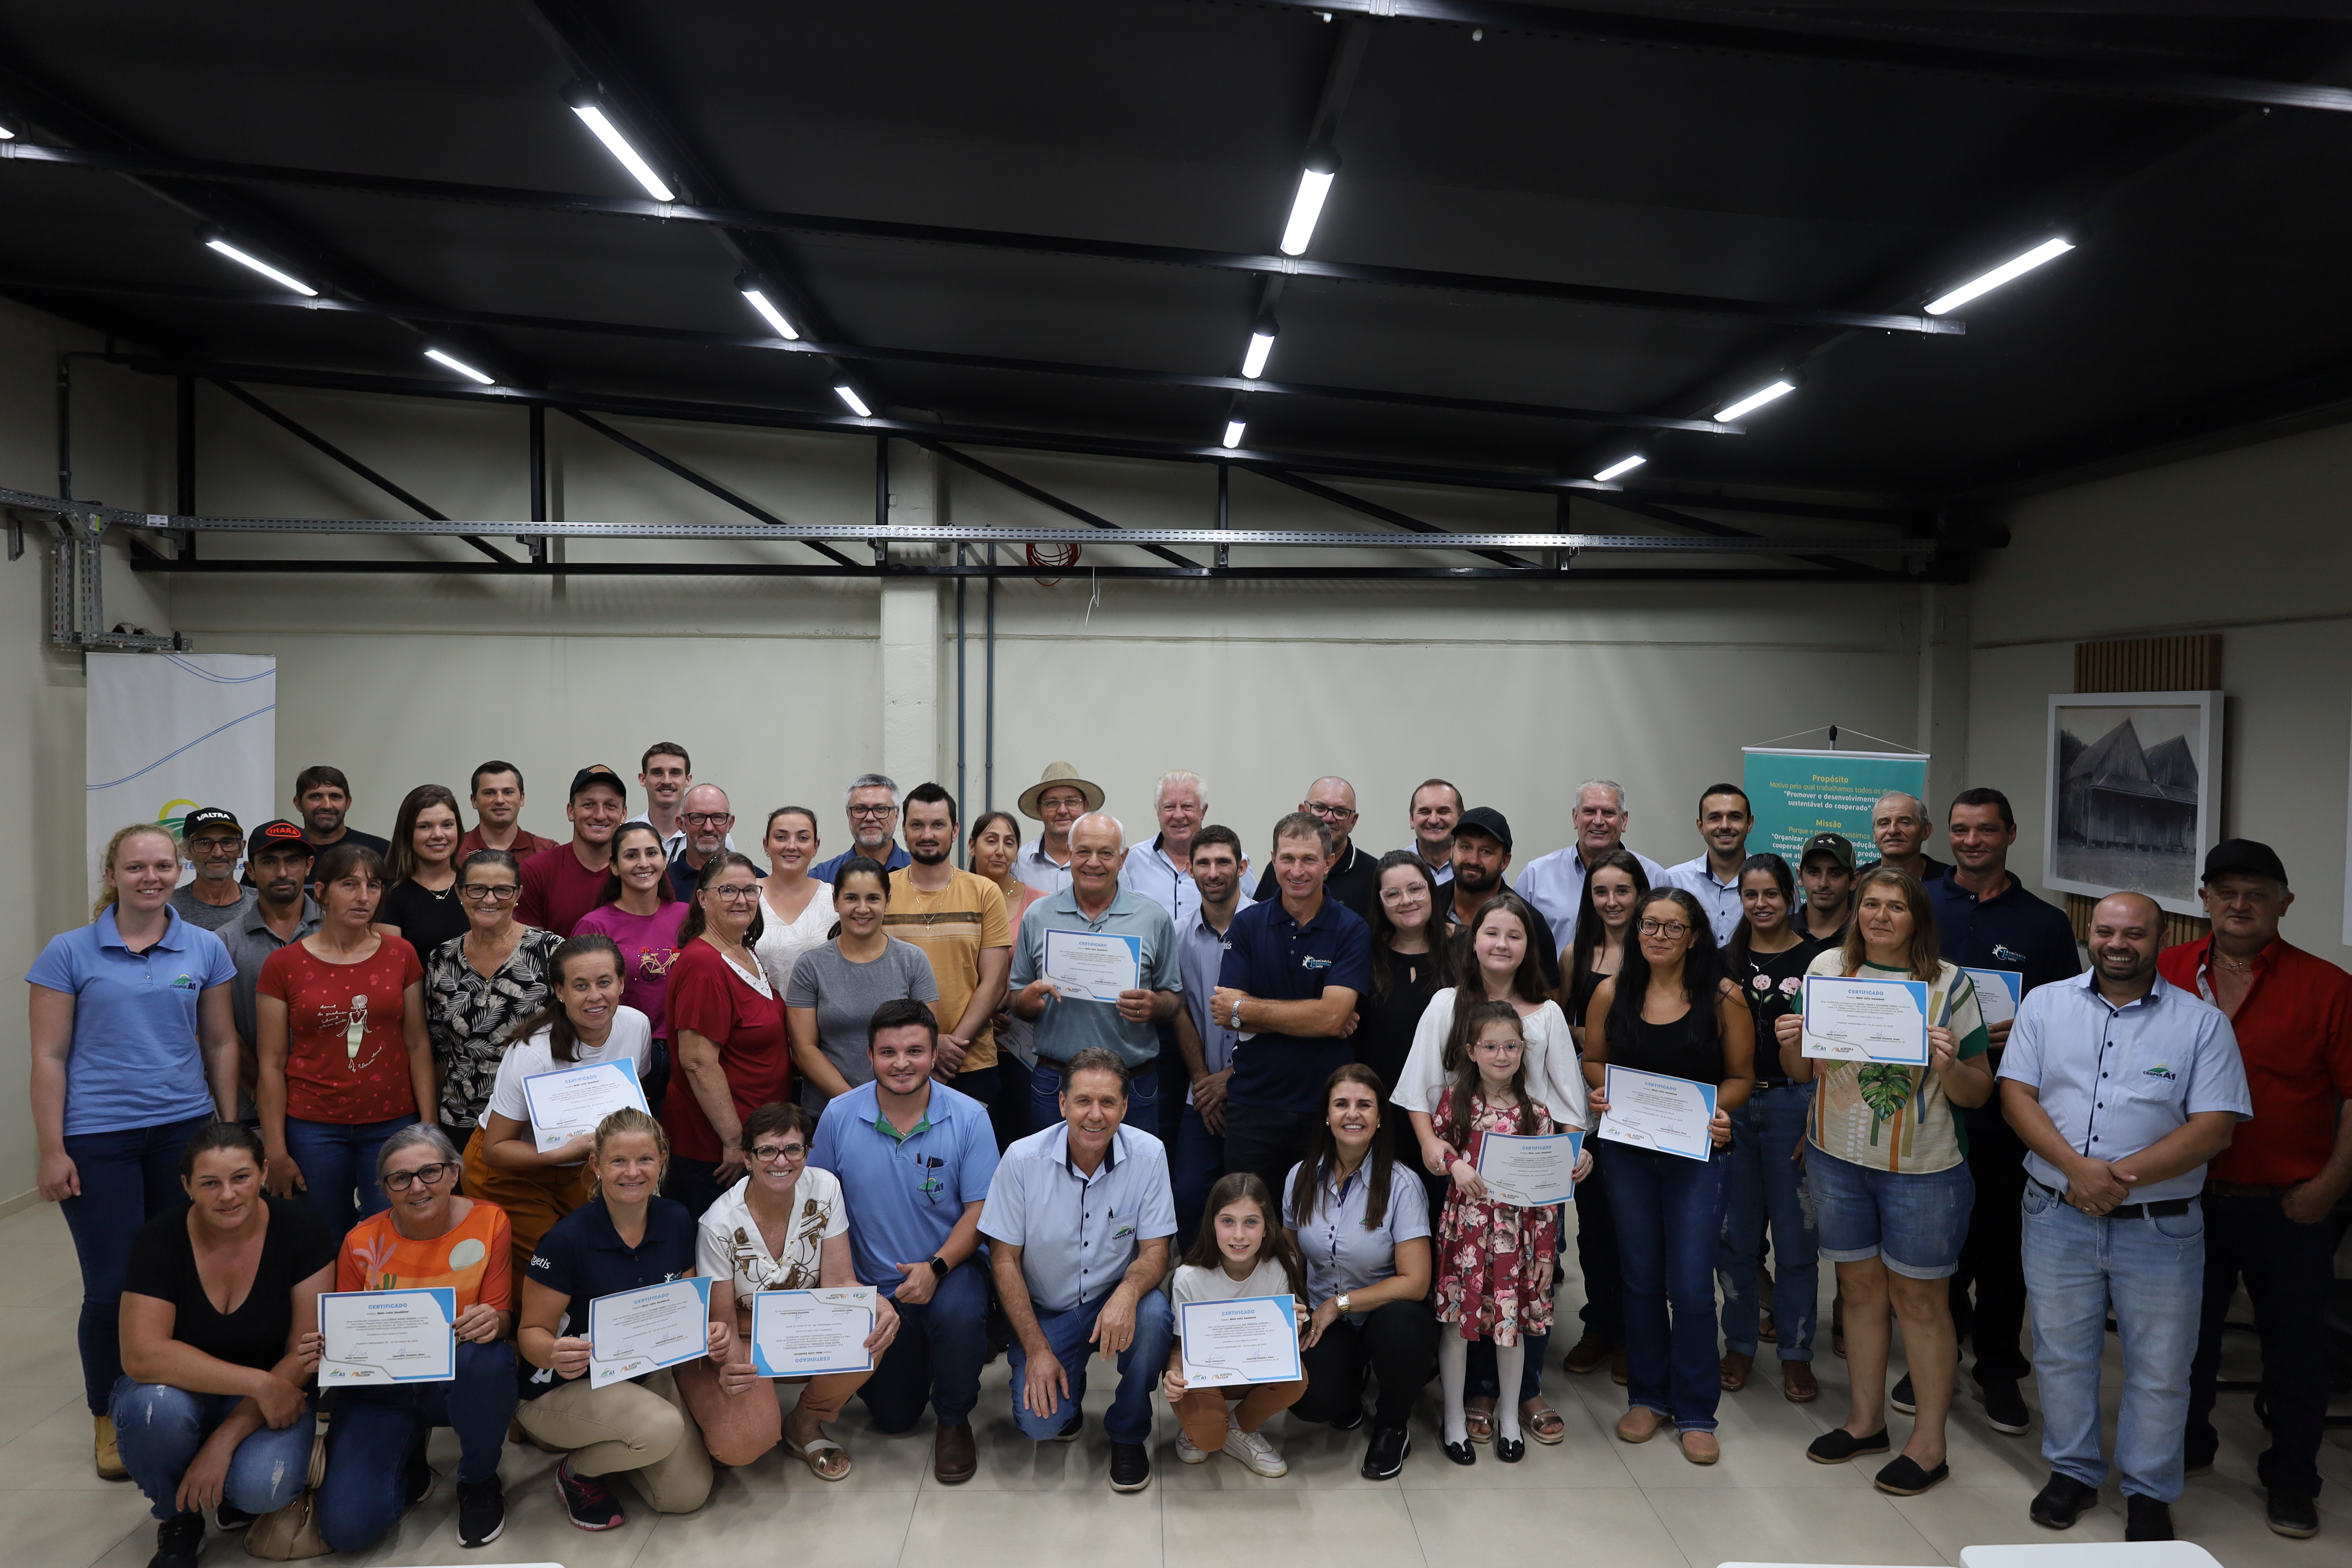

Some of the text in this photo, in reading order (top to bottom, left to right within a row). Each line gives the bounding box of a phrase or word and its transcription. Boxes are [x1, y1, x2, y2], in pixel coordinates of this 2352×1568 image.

[1812, 774, 1848, 783] Propósito
[1824, 793, 1878, 802] desenvolvimento
[196, 812, 230, 821] VALTRA
[1816, 819, 1842, 828] Missão
[1772, 833, 1803, 842] "Organizar
[565, 1075, 597, 1083] CERTIFICADO
[2162, 1072, 2176, 1081] A1
[1645, 1082, 1676, 1091] CERTIFICADO
[634, 1293, 669, 1304] CERTIFICADO
